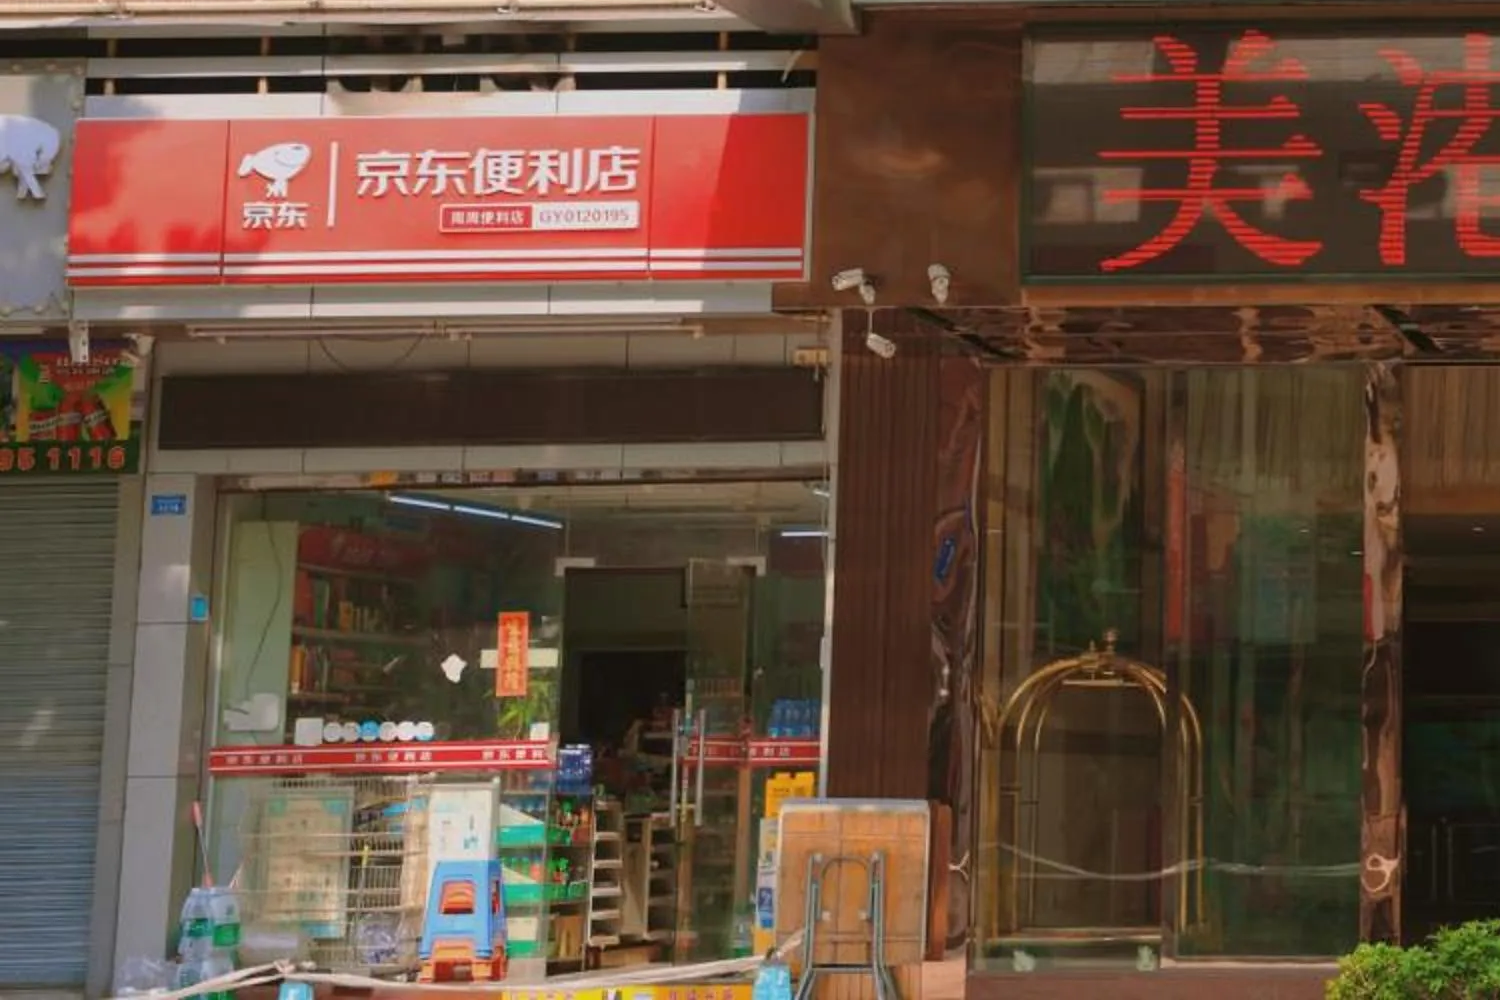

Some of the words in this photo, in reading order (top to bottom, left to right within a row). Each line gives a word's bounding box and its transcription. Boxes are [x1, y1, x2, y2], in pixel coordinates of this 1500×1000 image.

[356, 145, 641, 197] 京东便利店
[242, 201, 309, 230] 京东
